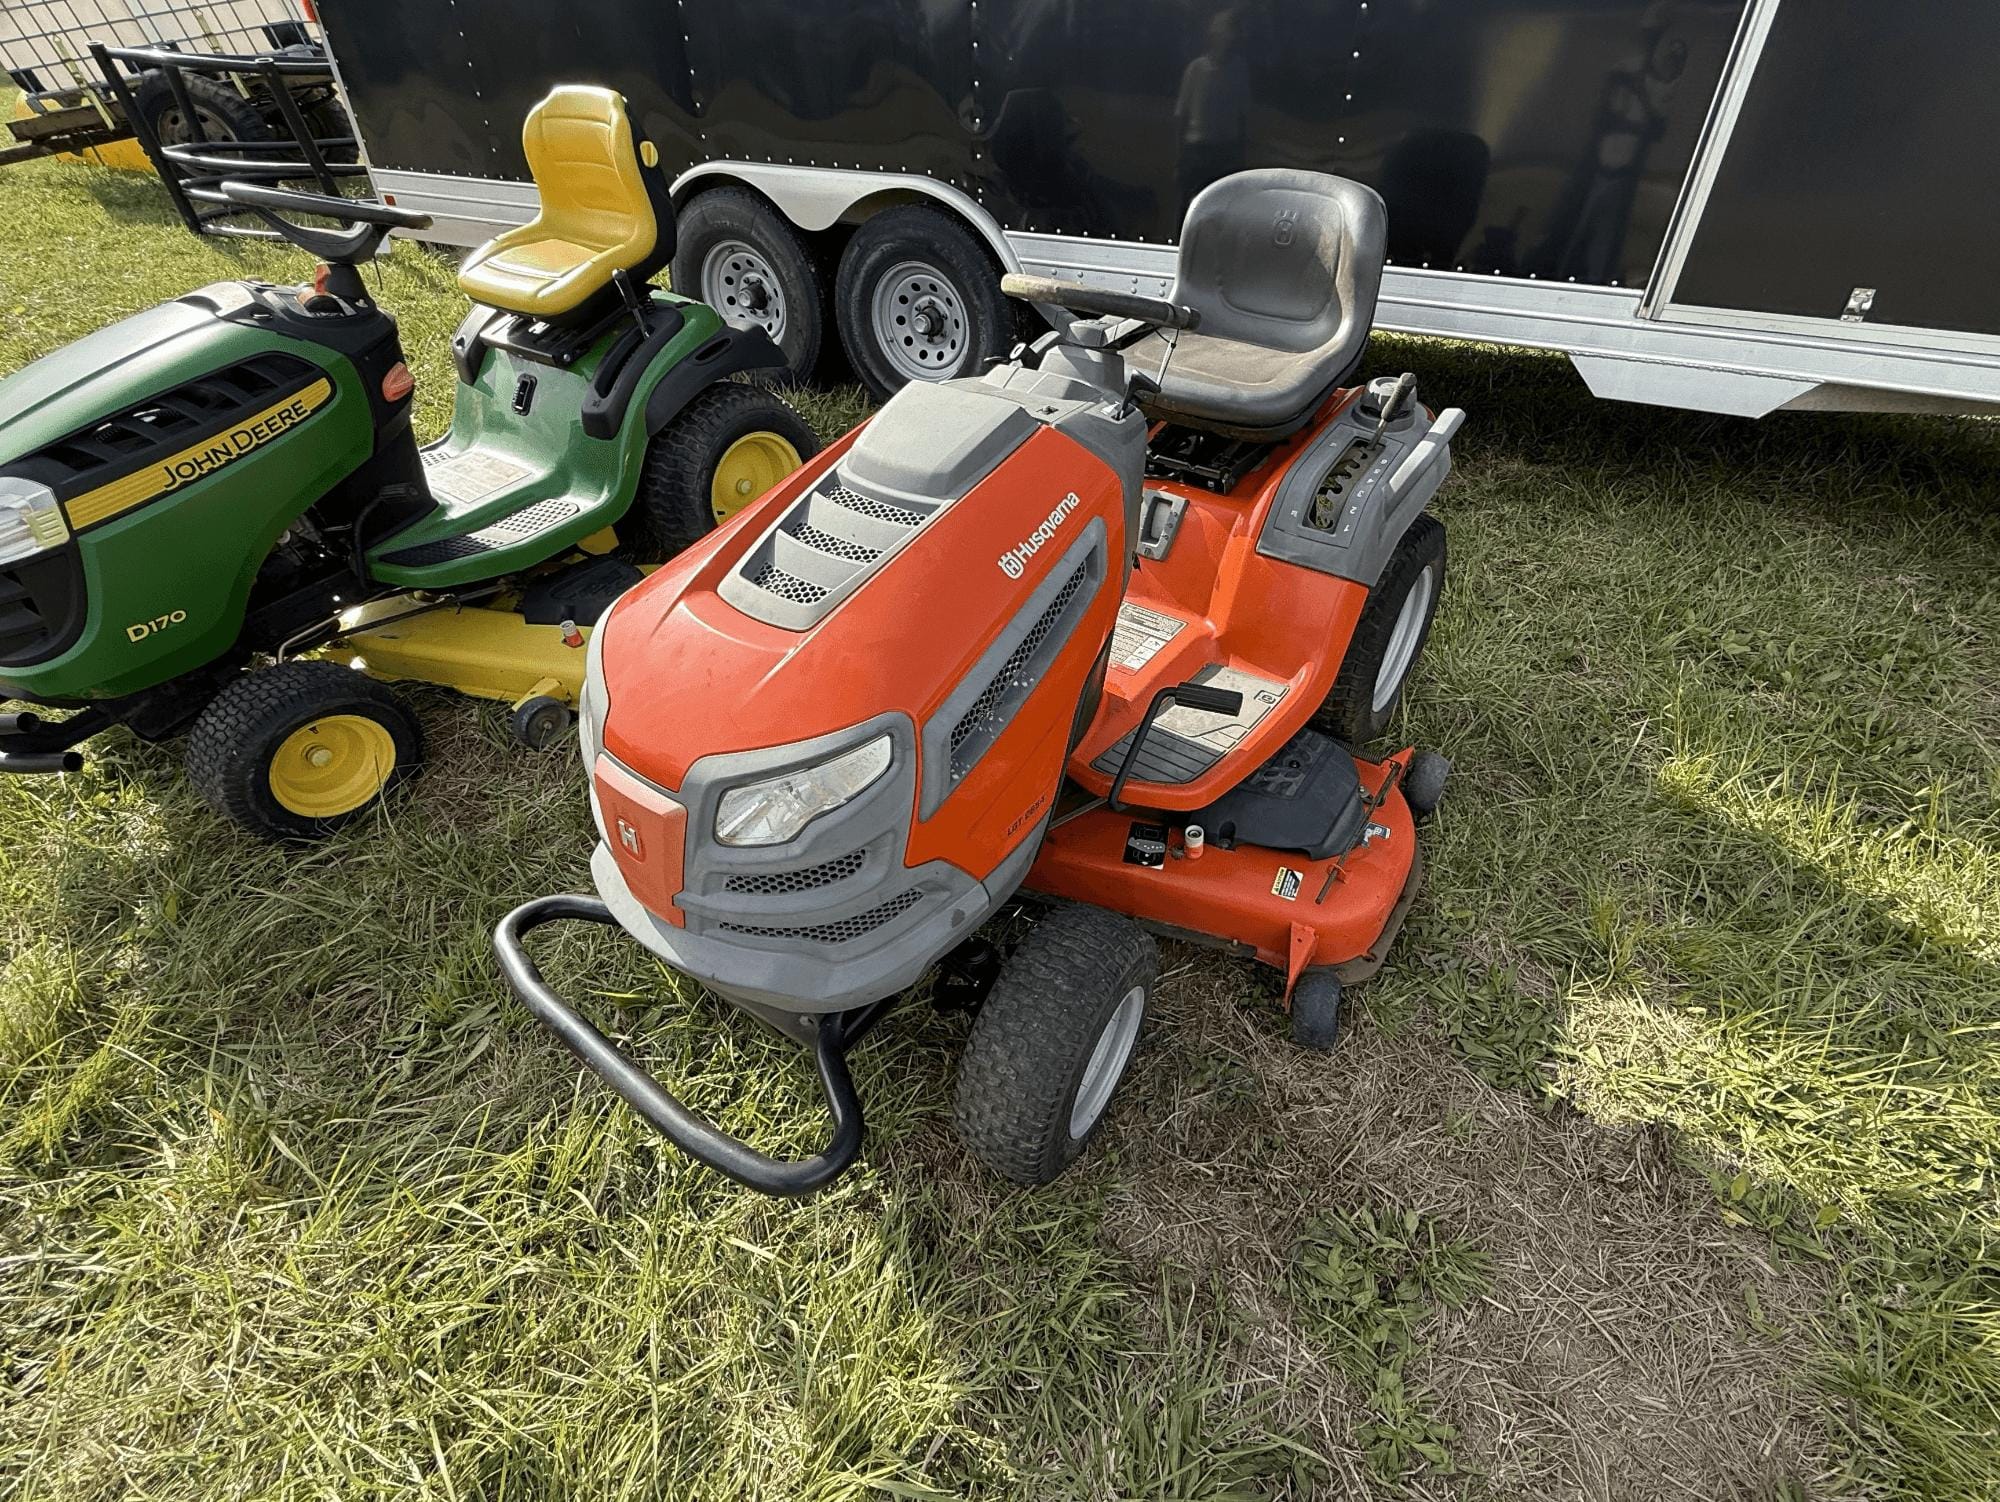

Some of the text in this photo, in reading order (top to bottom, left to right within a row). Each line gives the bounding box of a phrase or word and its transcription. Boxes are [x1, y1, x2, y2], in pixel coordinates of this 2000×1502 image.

[163, 399, 309, 489] JOHN DEERE
[1356, 490, 1365, 498] 3
[1349, 506, 1358, 515] 2
[1012, 491, 1081, 564] Husqvarna
[1343, 524, 1350, 533] 1
[126, 609, 187, 643] D170
